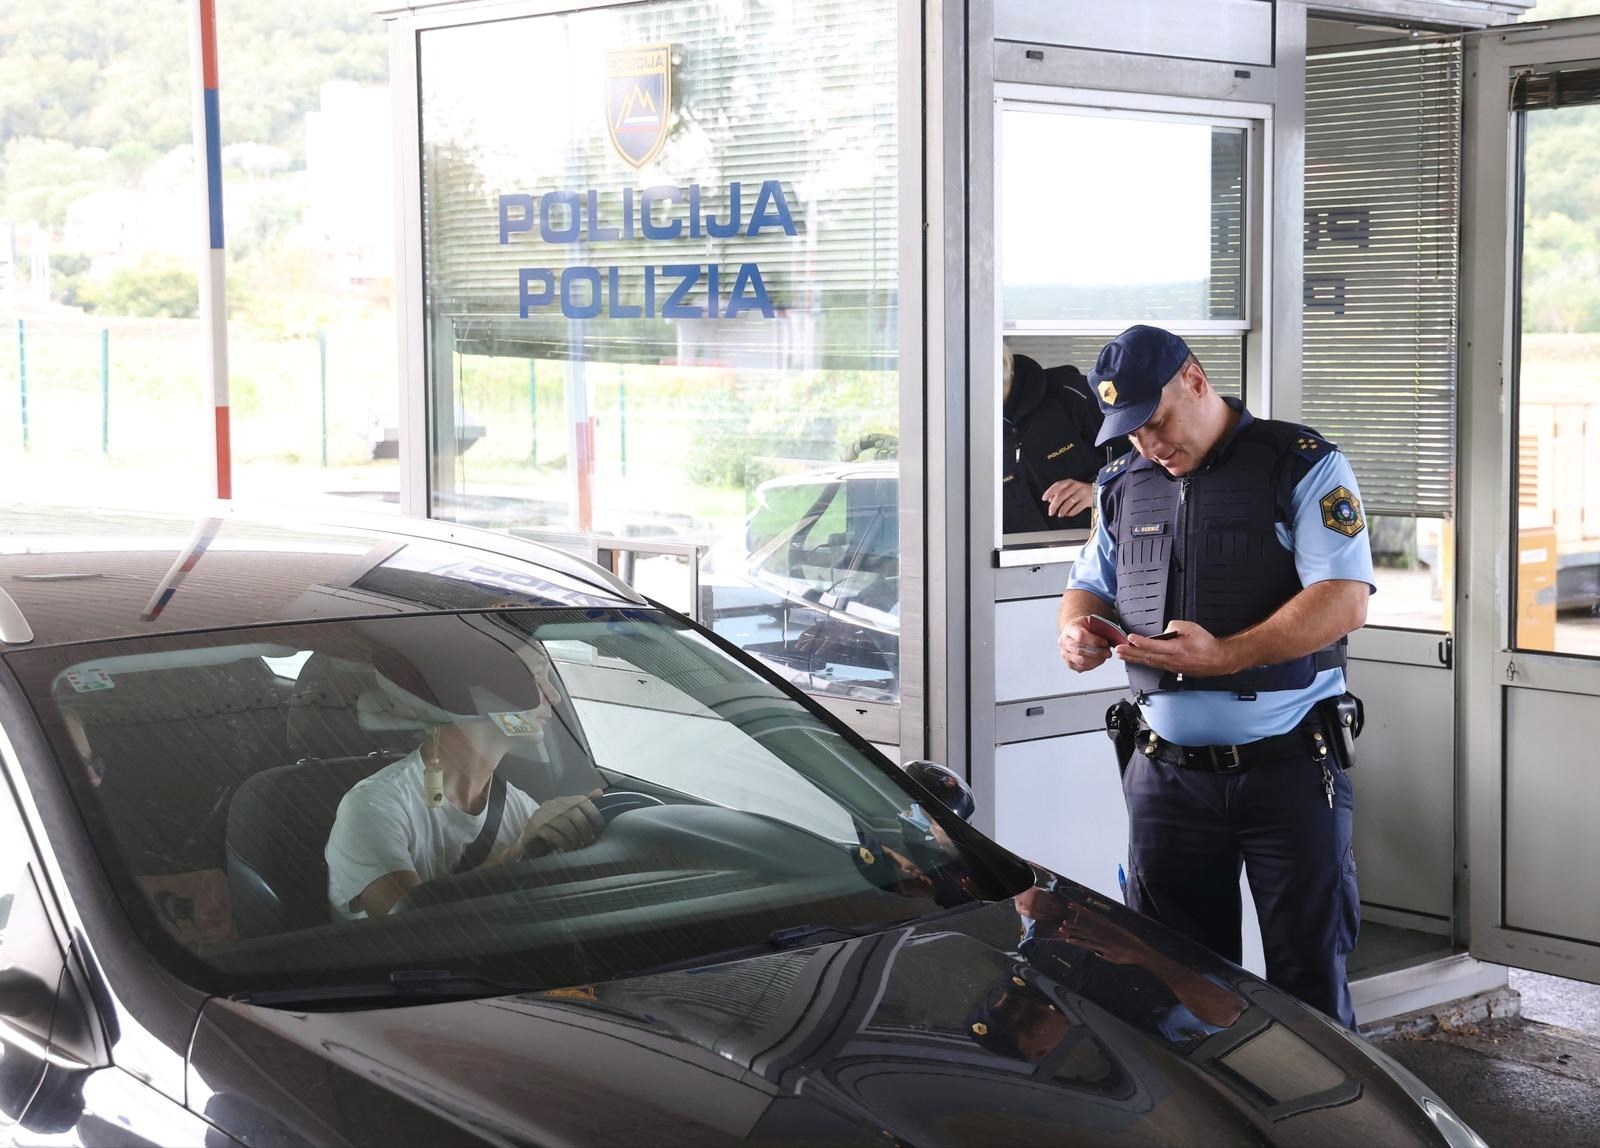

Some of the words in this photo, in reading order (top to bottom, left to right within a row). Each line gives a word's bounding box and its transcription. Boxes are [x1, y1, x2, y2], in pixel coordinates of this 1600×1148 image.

[499, 180, 798, 245] POLICIJA
[518, 263, 776, 319] POLIZIA
[1047, 442, 1075, 460] POLICIJA
